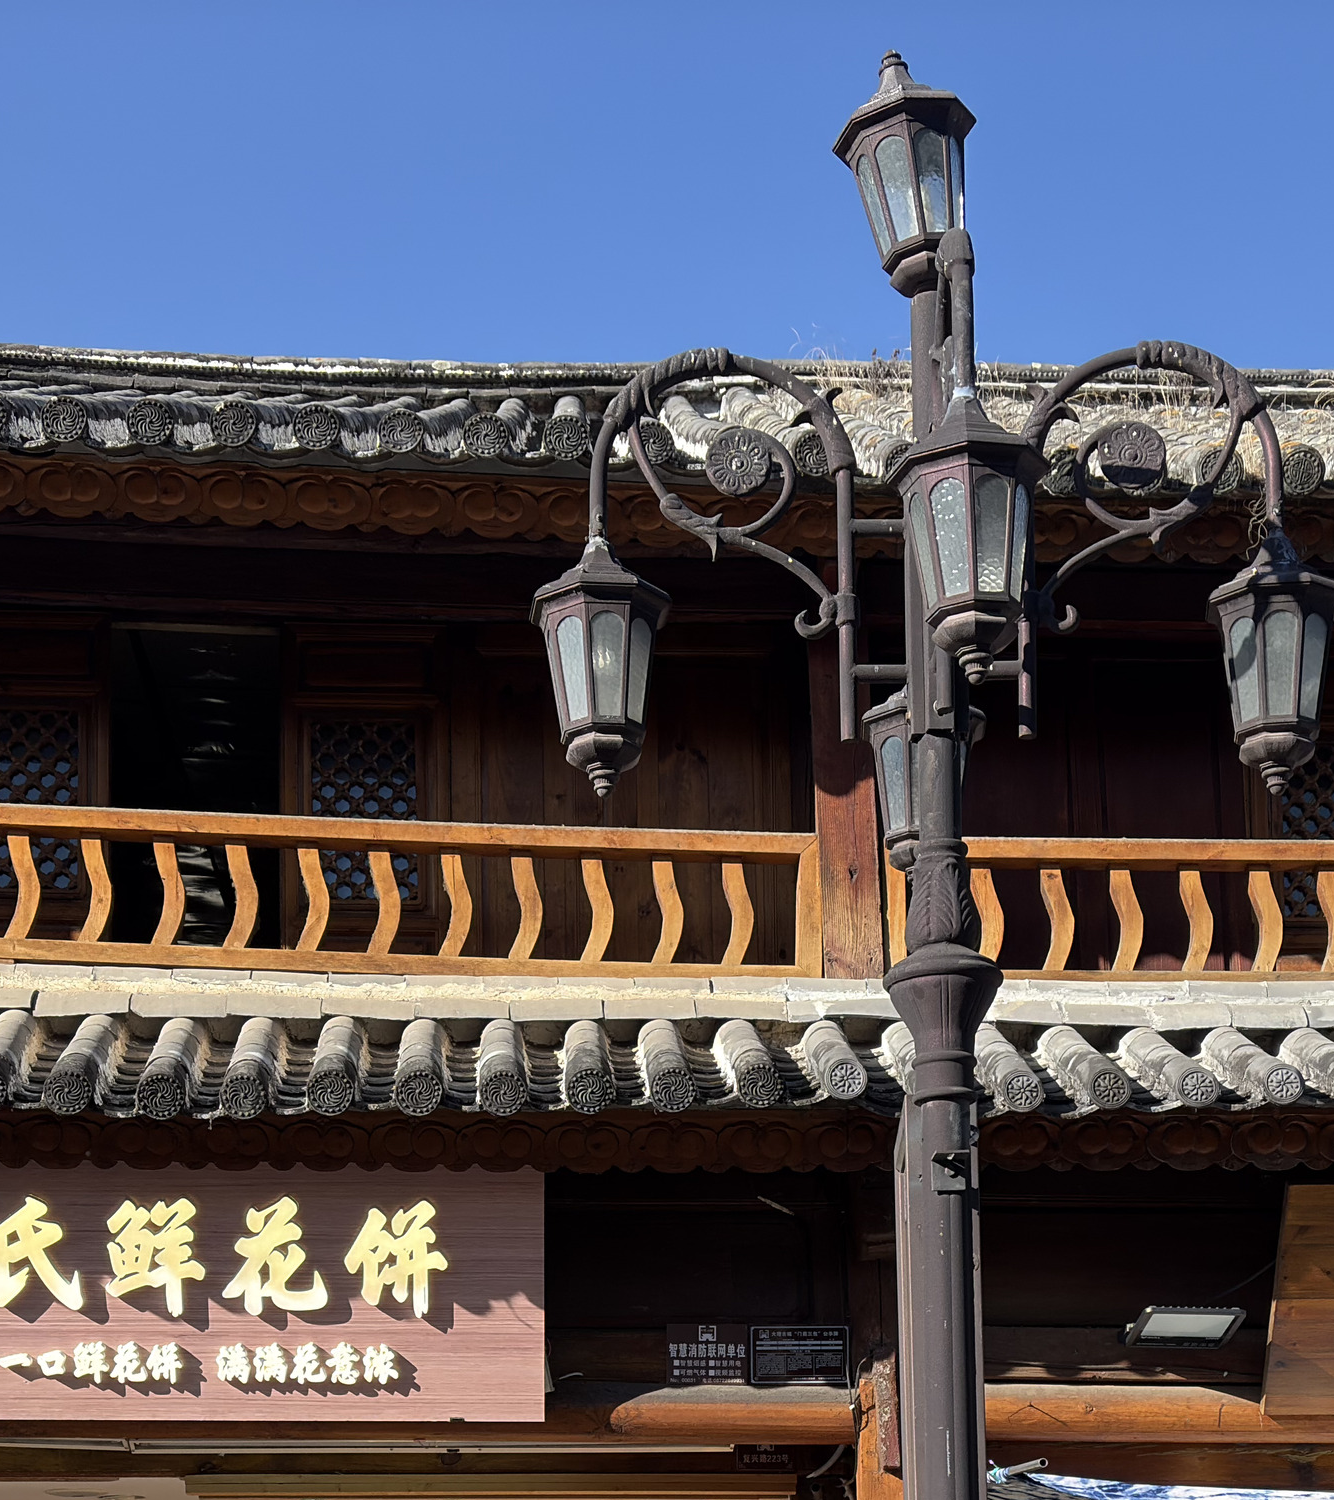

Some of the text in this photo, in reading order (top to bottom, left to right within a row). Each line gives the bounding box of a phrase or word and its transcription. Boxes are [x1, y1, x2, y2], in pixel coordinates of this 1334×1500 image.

[669, 1343, 746, 1358] 智慧消防联网单位
[215, 1342, 399, 1385] 满满花意浓
[742, 1454, 789, 1464] 复兴路223号
